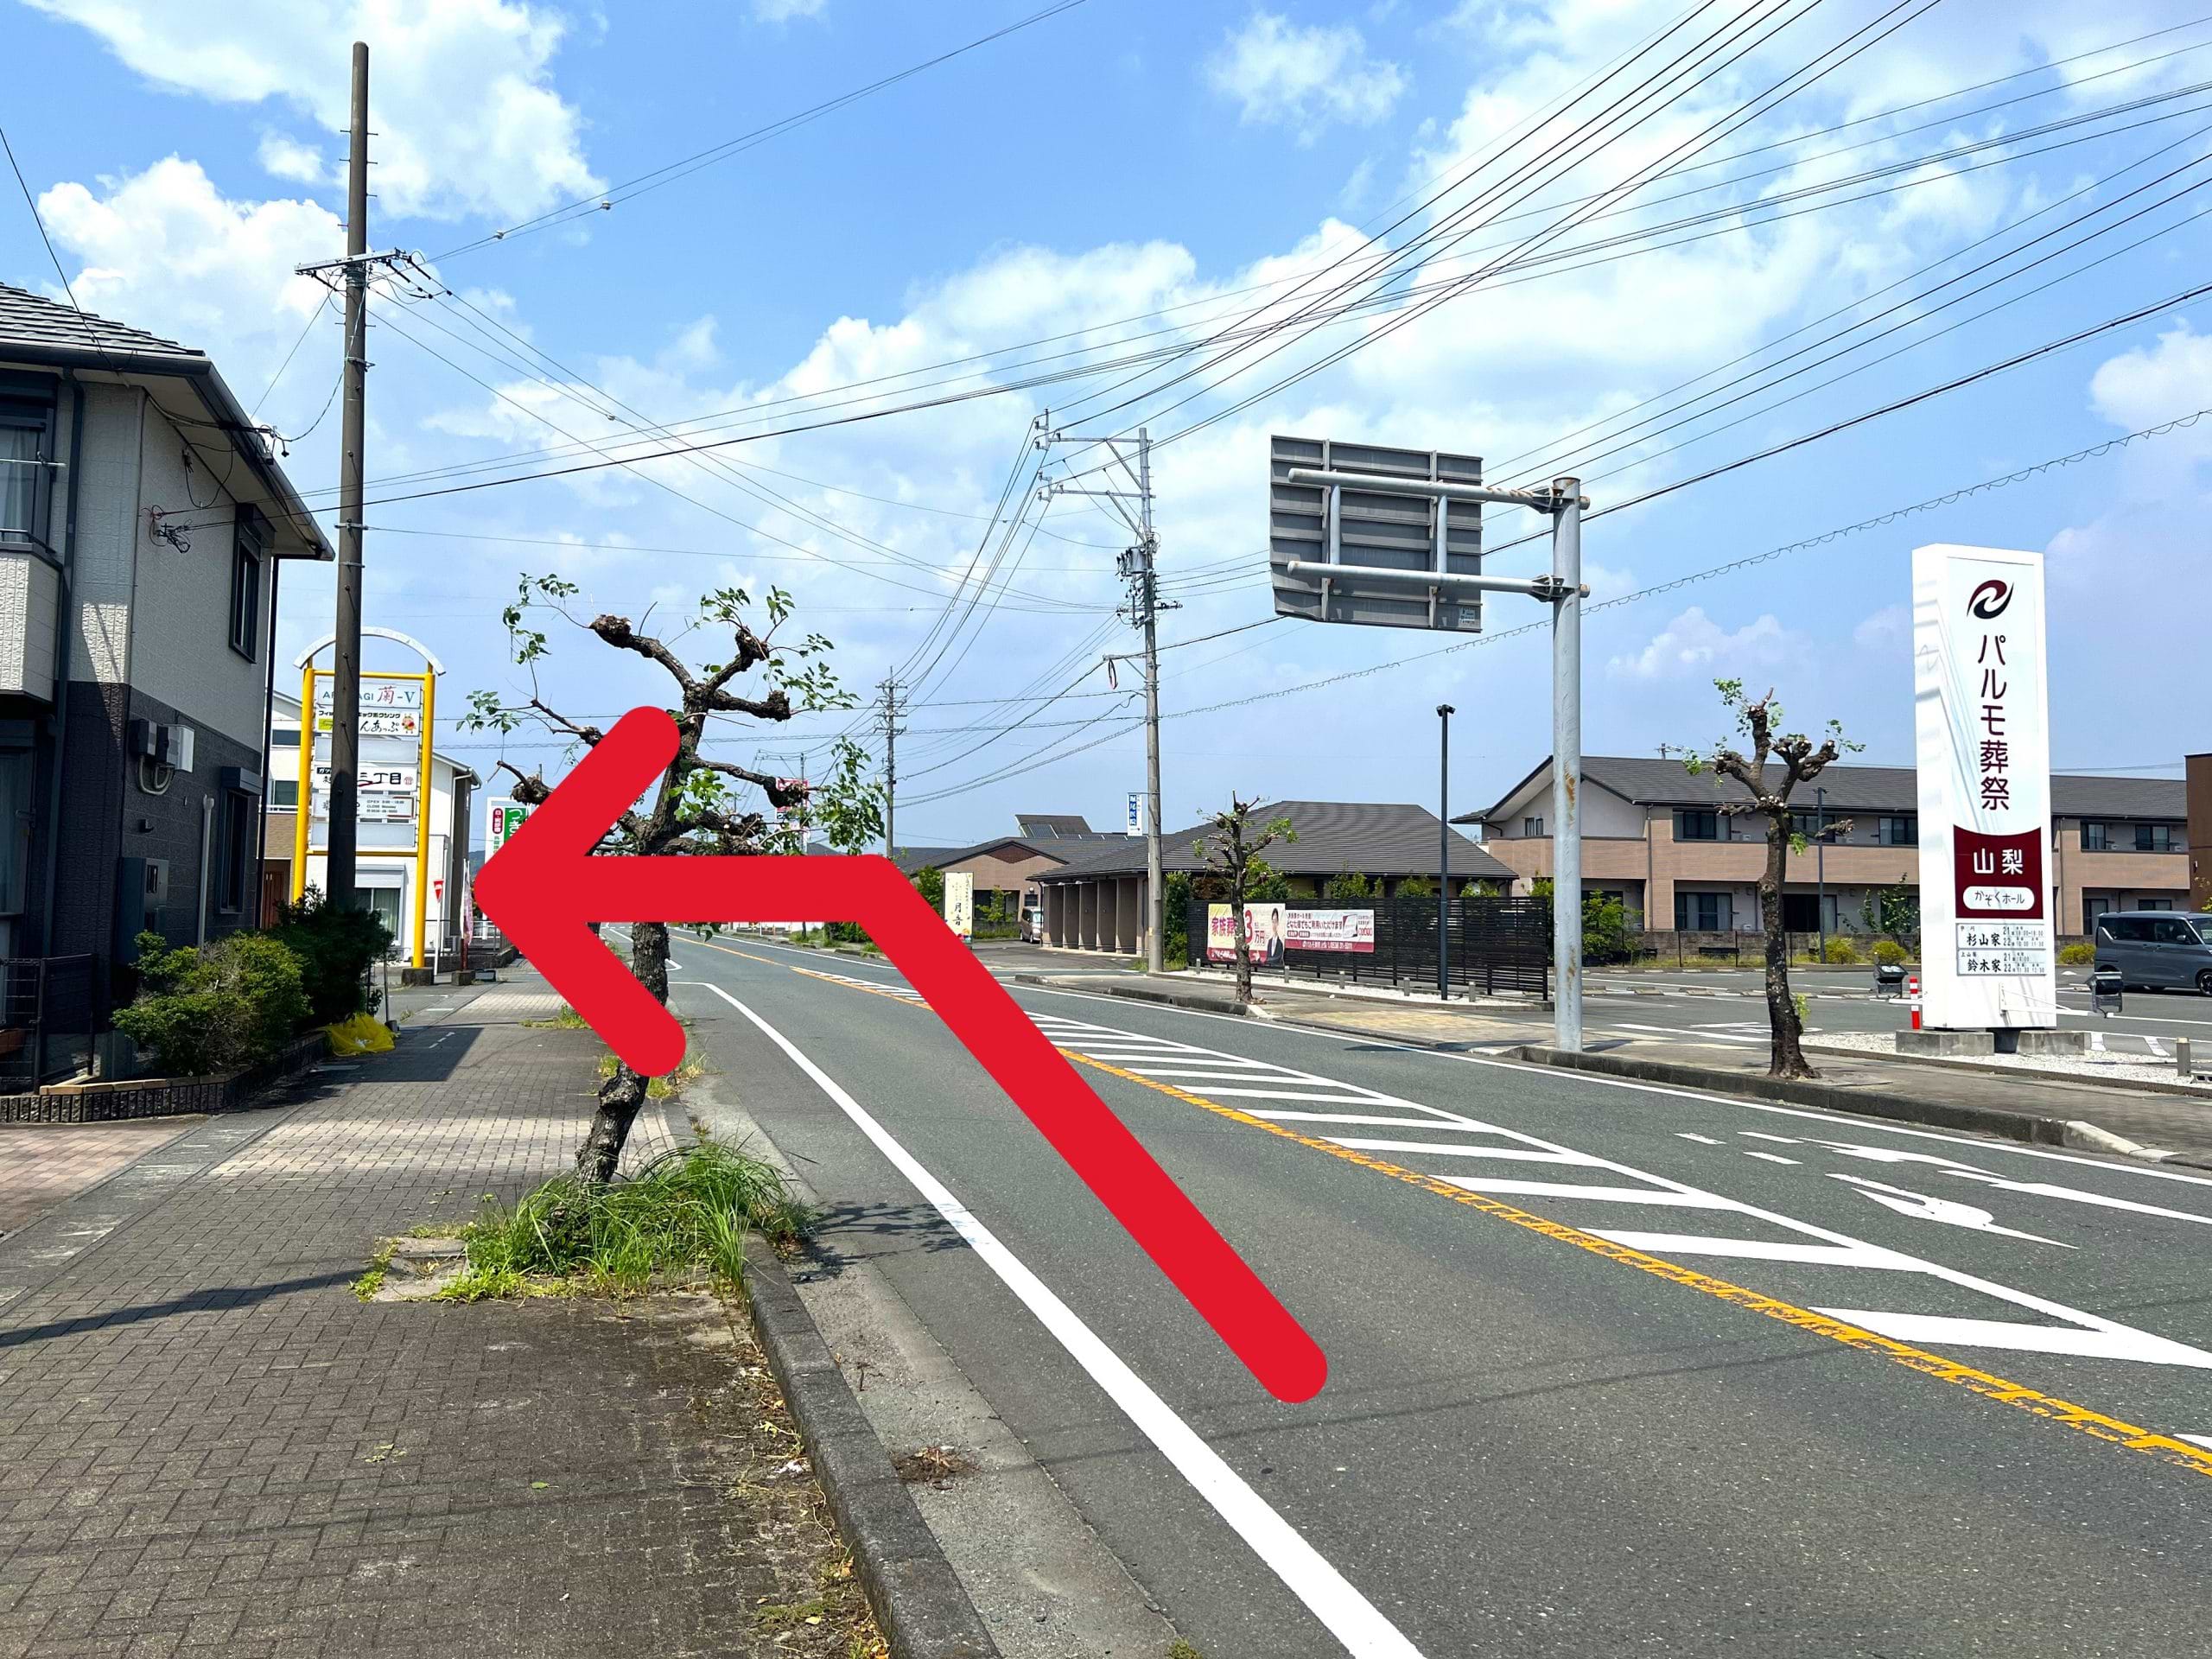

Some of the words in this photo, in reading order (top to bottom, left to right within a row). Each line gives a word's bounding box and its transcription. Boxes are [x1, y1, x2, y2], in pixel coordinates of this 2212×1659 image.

[1977, 634, 2010, 810] パルモ葬祭
[1973, 848, 2024, 875] 山梨
[1974, 890, 2025, 907] かぞくホール
[1966, 932, 2001, 947] 杉山家
[1967, 957, 2001, 972] 鈴木家
